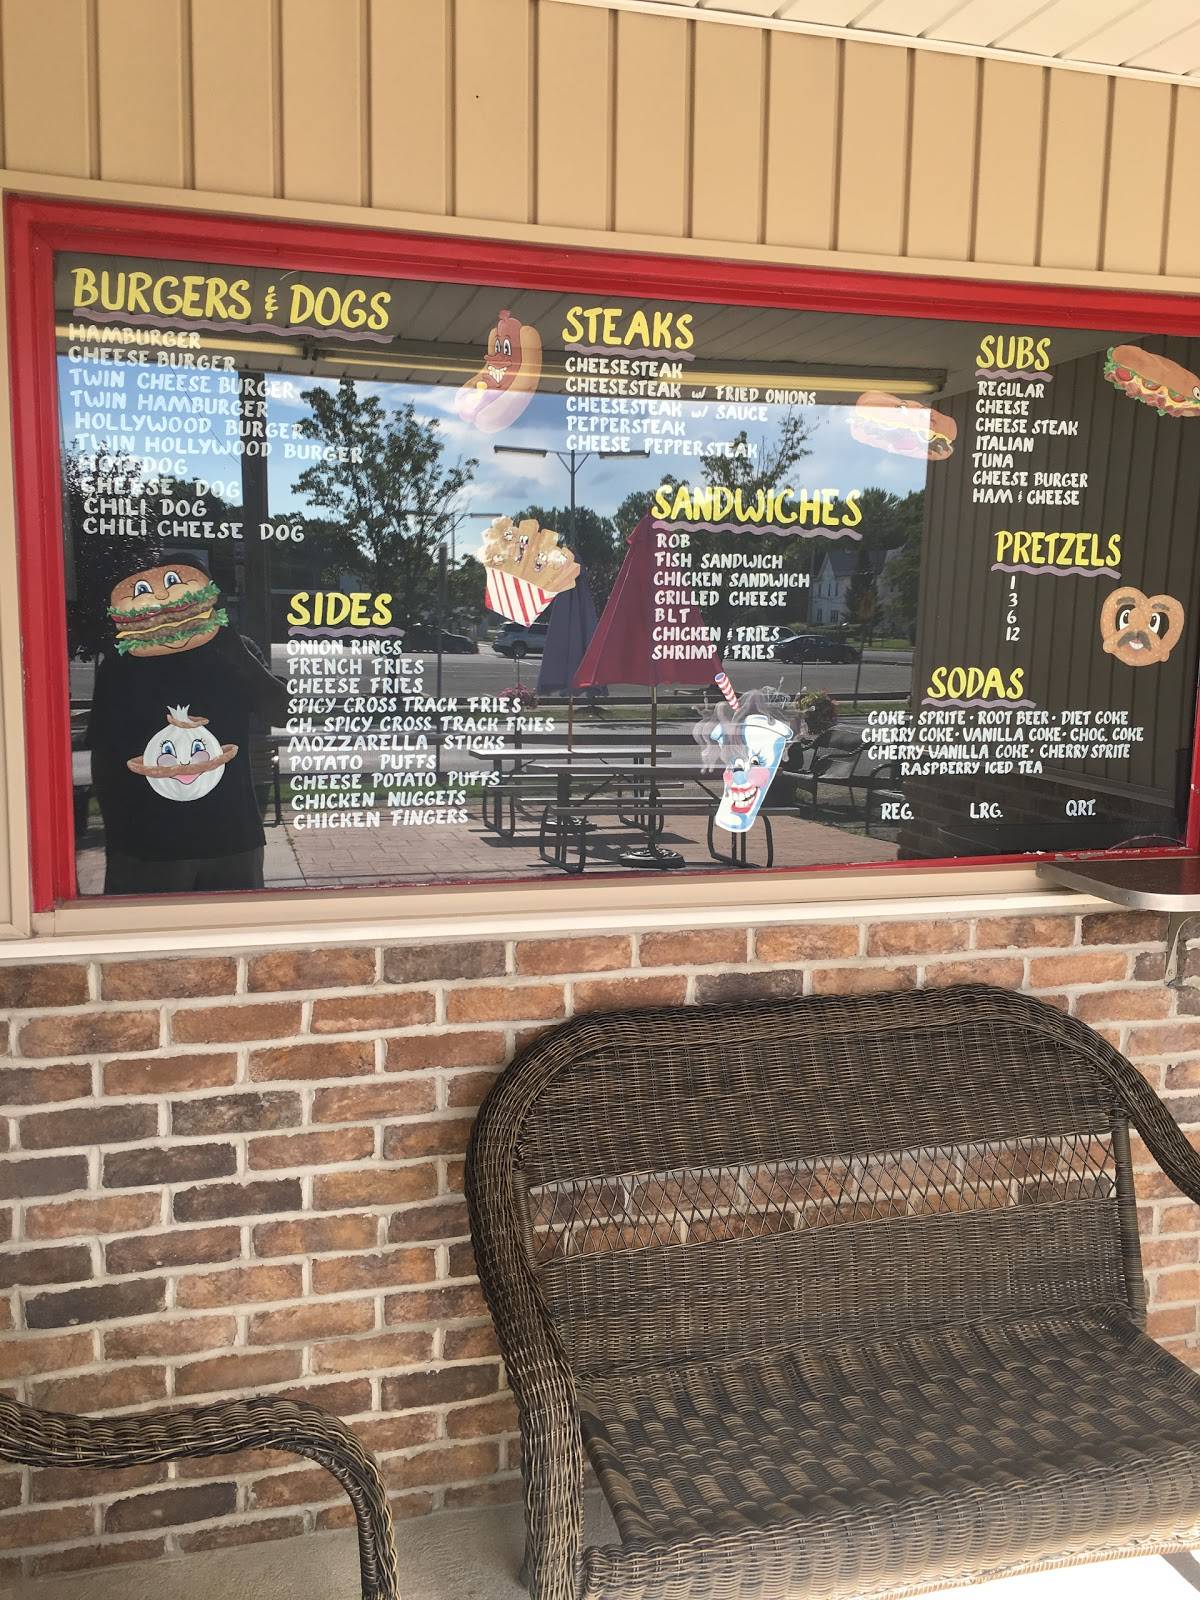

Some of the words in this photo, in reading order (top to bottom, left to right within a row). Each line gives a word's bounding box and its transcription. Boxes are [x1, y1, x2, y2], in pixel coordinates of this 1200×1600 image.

[71, 268, 251, 320] BURGERS
[289, 284, 391, 330] DOGS
[68, 324, 201, 349] HAMBURGER
[562, 306, 694, 350] STEAKS
[68, 345, 150, 367] CHEESE
[157, 351, 235, 372] BURGER
[975, 334, 1051, 371] SUBS
[565, 357, 683, 379] CHEESESTEAK
[69, 368, 125, 388] TWIN
[137, 372, 211, 393] CHEESE
[219, 376, 294, 399] BURGER
[565, 377, 681, 399] CHEESESTEAK
[691, 388, 706, 399] w/
[715, 386, 759, 402] FRIED
[765, 389, 816, 406] ONIONS
[977, 381, 1045, 399] REGULAR
[70, 389, 127, 409] TWIN
[137, 393, 268, 417] HAMBURGER
[566, 397, 682, 417] CHEESESTEAK
[691, 407, 708, 419] w/
[716, 405, 768, 422] SAUCE
[976, 399, 1029, 416] CHEESE
[75, 411, 212, 434] HOLLYWOOD
[225, 420, 304, 440] BURGER
[566, 416, 686, 436] PEPPERSTEAK
[976, 417, 1026, 434] CHEESE
[1031, 419, 1079, 436] STEAK
[75, 432, 135, 452] TWIN
[145, 436, 272, 457] HOLLYWOOD
[284, 443, 363, 464] BURGER
[566, 435, 630, 452] CHEESE
[644, 438, 758, 459] PEPPERSTEAK
[976, 435, 1034, 453] ITALIAN
[141, 456, 188, 475] DOG
[972, 452, 1014, 468] TUNA
[80, 477, 174, 497] CHEESE
[196, 479, 240, 498] DOG
[973, 471, 1028, 487] CHEESE
[1034, 472, 1089, 488] BURGER
[651, 484, 863, 527] SANDWICHES
[973, 488, 1013, 504] HAM
[1026, 490, 1080, 506] CHEESE
[83, 498, 147, 516] CHILI
[160, 499, 207, 517] DOG
[82, 516, 147, 536] CHILI
[157, 520, 244, 539] CHEESE
[260, 523, 305, 543] DOG
[656, 533, 691, 548] ROB
[994, 530, 1122, 567] PRETZELS
[655, 551, 691, 568] FISH
[700, 553, 783, 569] SANDWICH
[653, 571, 722, 587] CHICKEN
[729, 572, 810, 588] SANDWICH
[1010, 575, 1016, 590] 1
[655, 590, 720, 606] GRILLED
[729, 591, 788, 607] CHEESE
[1008, 592, 1018, 607] 3
[287, 591, 393, 627] SIDES
[1006, 610, 1017, 624] 6
[652, 627, 721, 642] CHICKEN
[736, 626, 780, 642] FRIES
[1006, 627, 1021, 641] 12
[287, 639, 344, 656] ONION
[350, 639, 403, 657] RINGS
[652, 644, 717, 661] SHRIMP
[732, 645, 775, 660] FRIES
[287, 658, 362, 676] FRENCH
[371, 658, 425, 675] FRIES
[287, 678, 360, 696] CHEESE
[370, 677, 424, 695] FRIES
[926, 666, 1025, 699] SODAS
[287, 697, 337, 715] SPICY
[343, 696, 397, 714] CROSS
[403, 697, 458, 713] TRACK
[467, 696, 522, 714] FRIES
[286, 717, 316, 734] CH.
[324, 717, 372, 734] SPICY
[380, 716, 432, 732] CROSS
[440, 716, 500, 732] TRACK
[506, 716, 555, 732] FRIES
[918, 710, 966, 726] SPRITE
[977, 710, 1013, 725] ROOT
[1016, 710, 1049, 725] BEER
[1061, 710, 1091, 725] DIET
[1094, 710, 1129, 725] COKE
[287, 734, 428, 753] MOZZARELLA
[443, 734, 505, 751] STICKS
[861, 727, 916, 744] CHERRY
[963, 728, 1024, 742] VANILLA
[1070, 727, 1108, 742] CHOC.
[1112, 727, 1144, 742] COKE
[867, 744, 923, 760] CHERRY
[928, 744, 989, 759] VANILLA
[1039, 743, 1090, 759] CHERRY
[1090, 743, 1130, 759] SPRITE
[289, 754, 363, 773] POTATO
[380, 754, 437, 771] PUFFS
[900, 761, 980, 776] RASPBERRY
[984, 760, 1013, 775] ICED
[1018, 760, 1043, 774] TEA
[290, 774, 362, 791] CHEESE
[372, 771, 437, 789] POTATO
[449, 770, 500, 787] PUFFS
[291, 792, 375, 811] CHICKEN
[387, 790, 467, 808] NUGGETS
[970, 801, 1003, 819] LRG.
[1065, 799, 1097, 817] QRT.
[293, 811, 380, 830] CHICKEN
[390, 808, 468, 826] FINGERS
[881, 802, 915, 820] REG.
